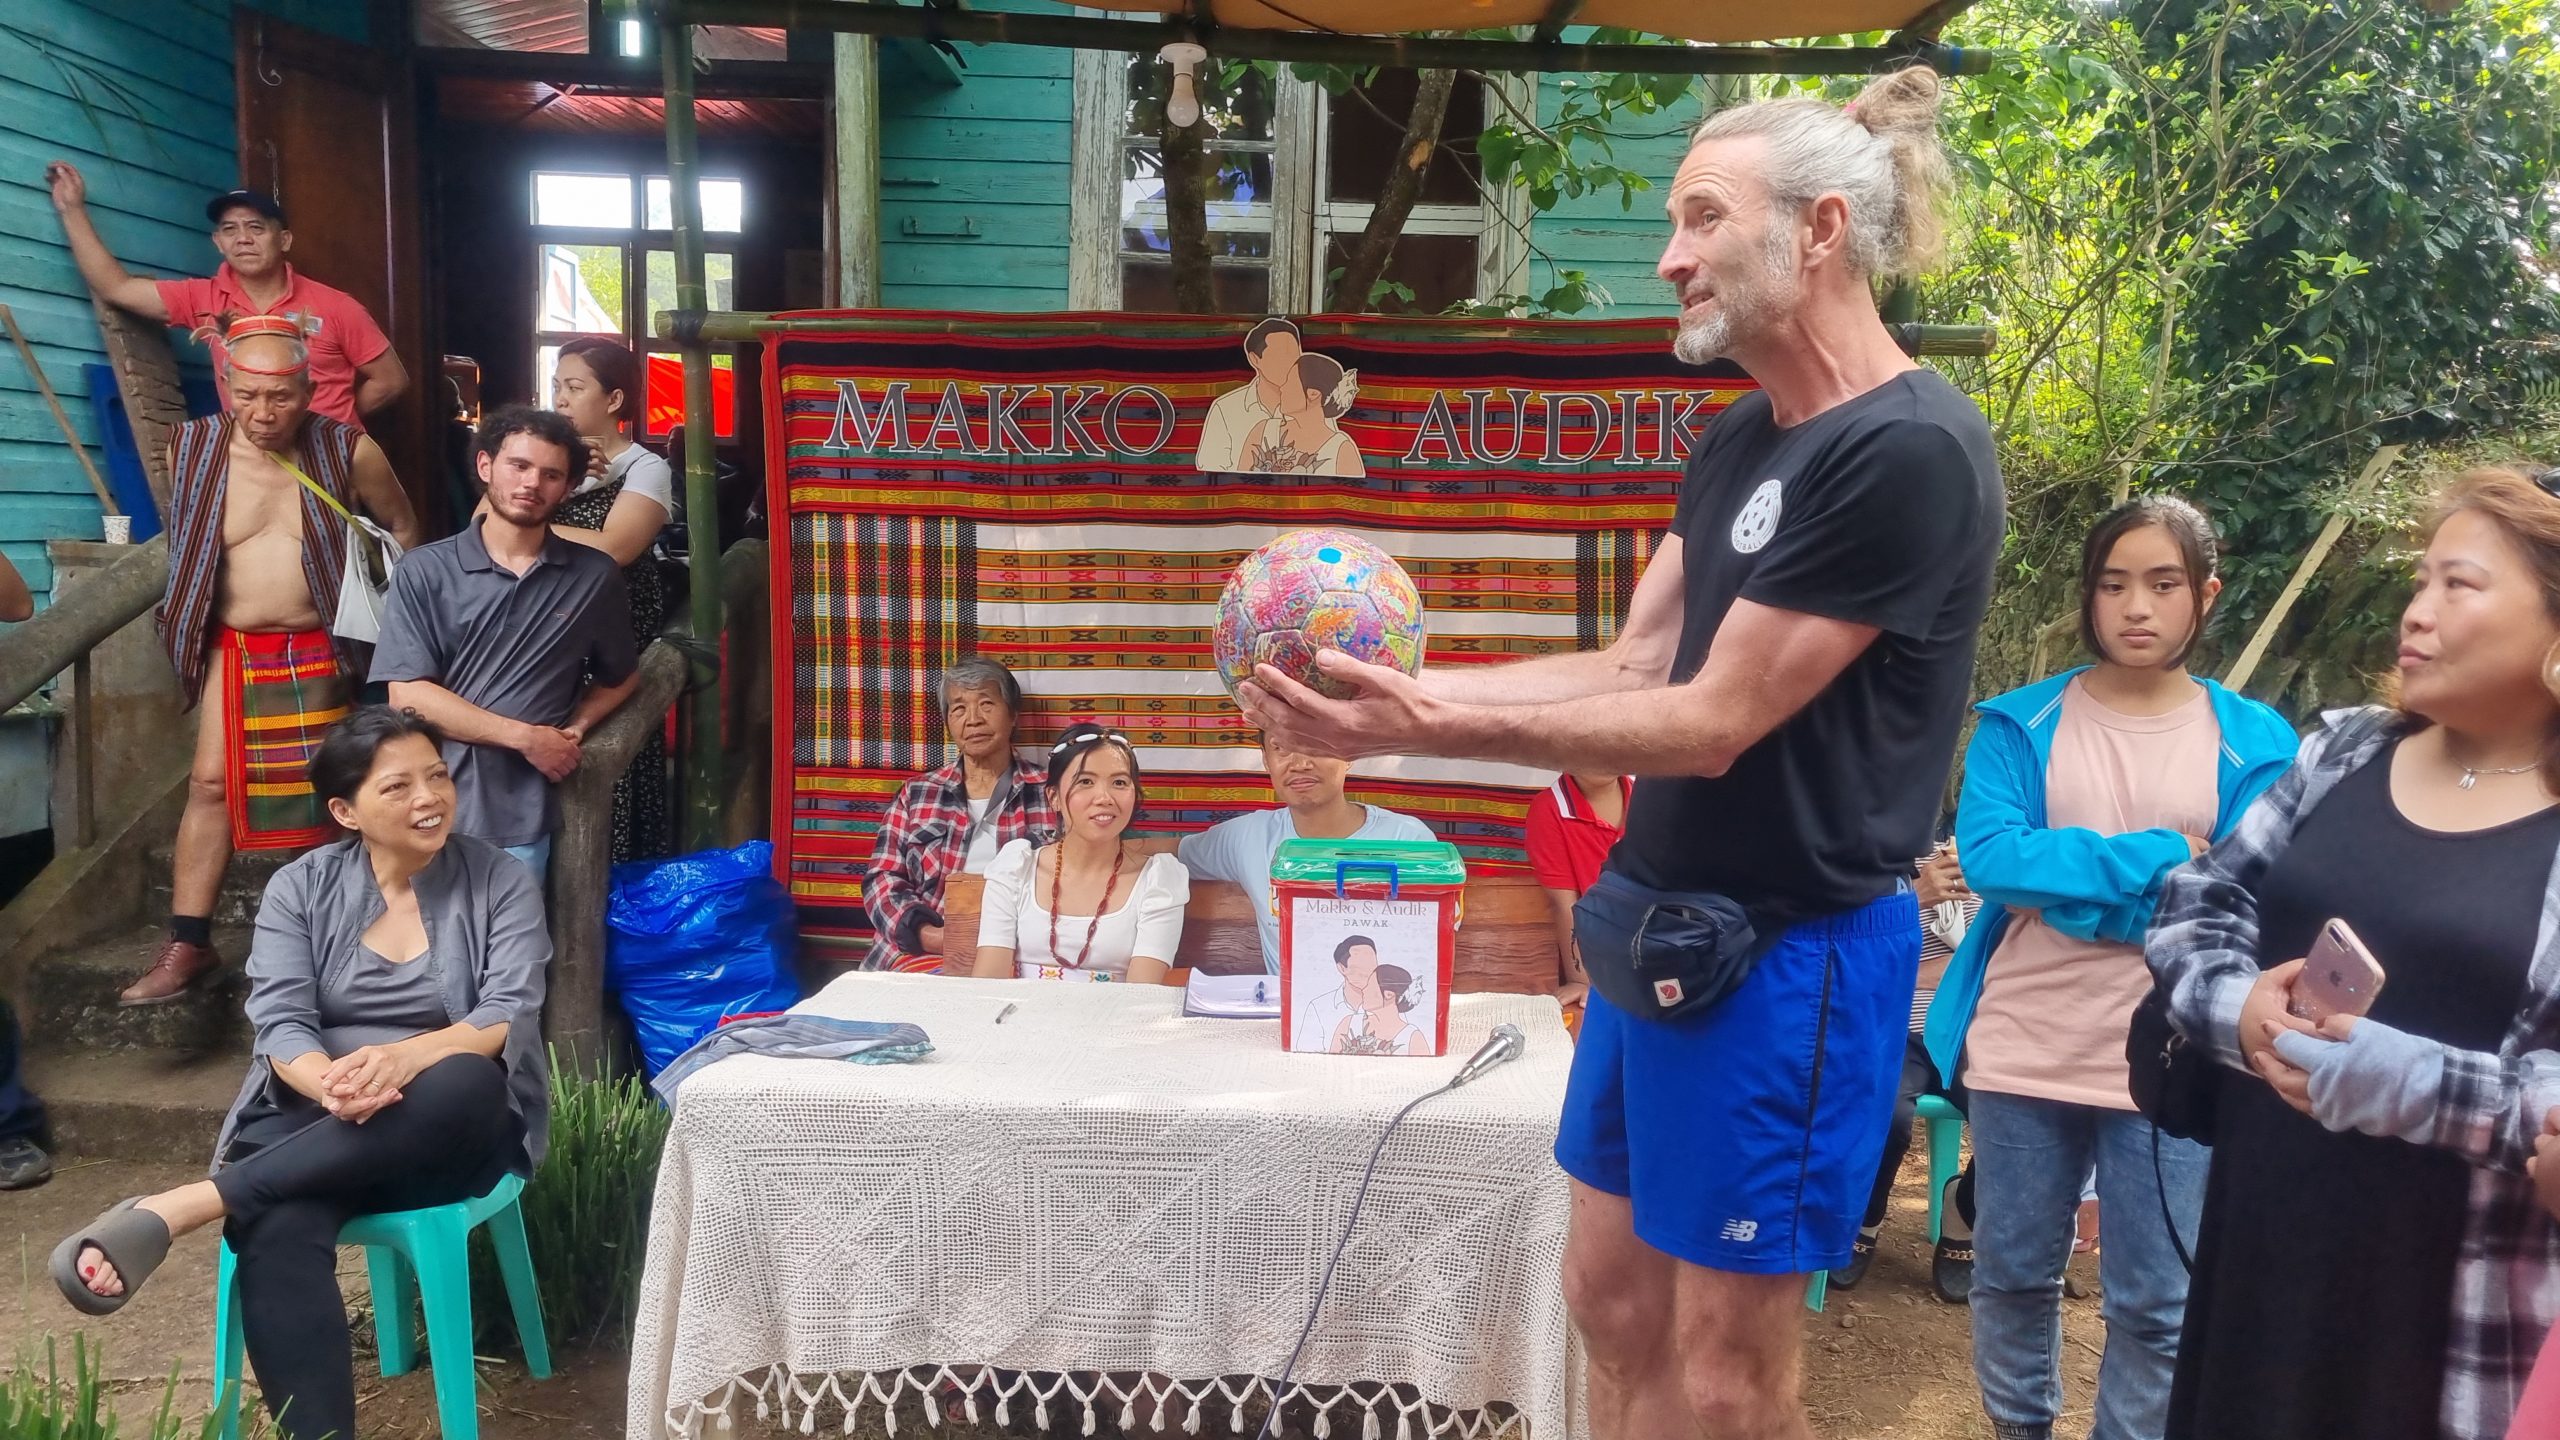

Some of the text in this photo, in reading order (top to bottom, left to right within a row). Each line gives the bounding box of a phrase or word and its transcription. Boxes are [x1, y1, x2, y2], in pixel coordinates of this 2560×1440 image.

[823, 379, 1176, 457] MAKKO
[1402, 386, 1716, 467] AUDIK
[1306, 899, 1427, 917] Makko & Audik
[1343, 918, 1389, 928] DAWAK
